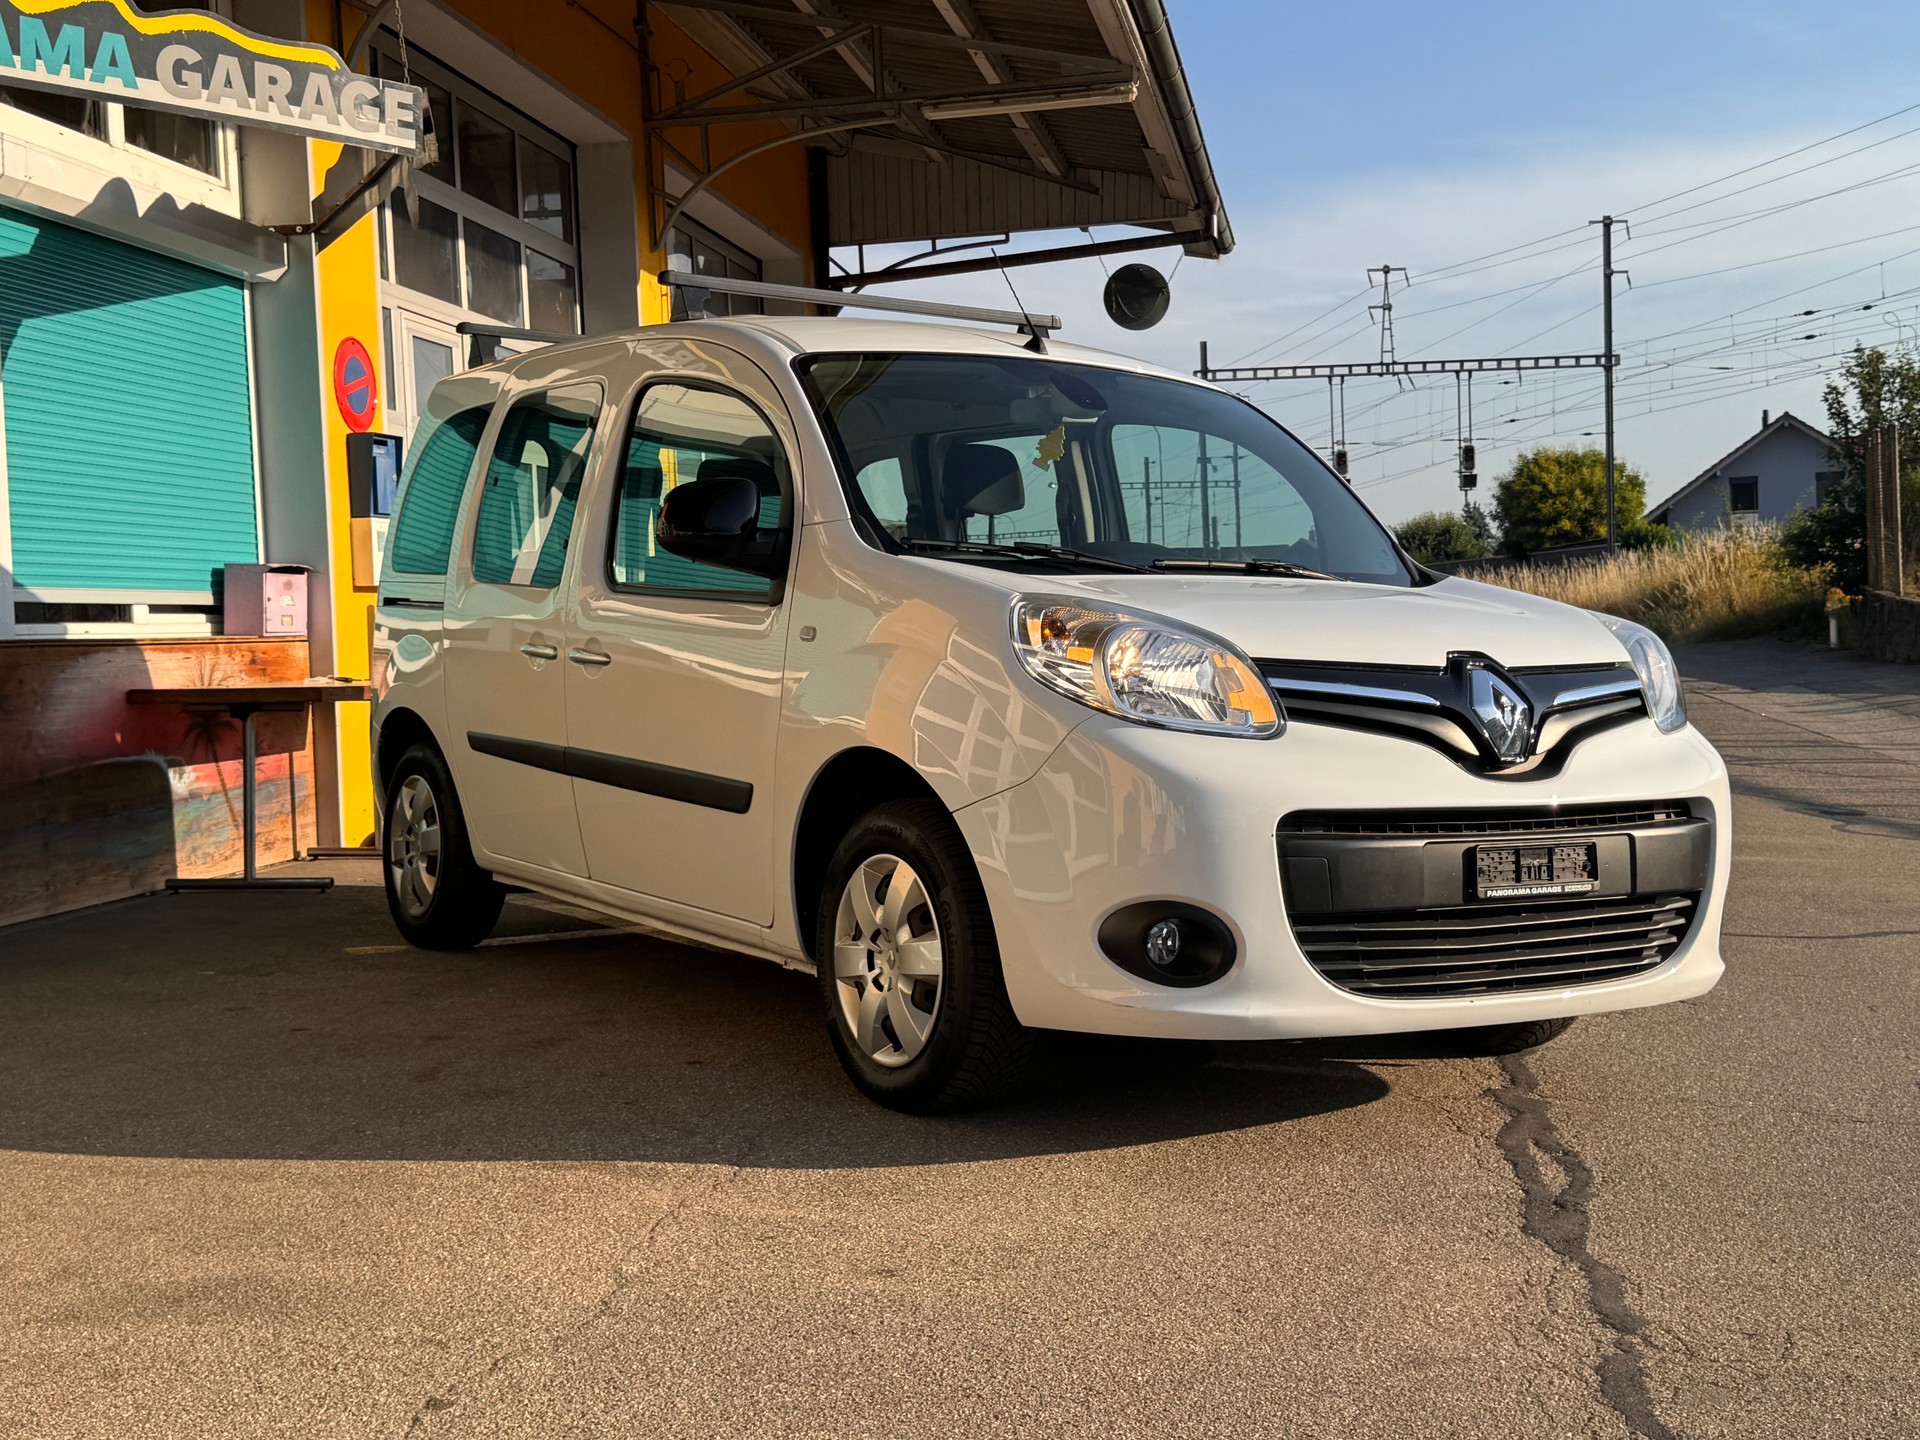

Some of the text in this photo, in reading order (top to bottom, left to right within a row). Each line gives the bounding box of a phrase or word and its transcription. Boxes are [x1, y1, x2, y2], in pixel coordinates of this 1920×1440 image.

[155, 44, 417, 138] GARAGE
[1487, 887, 1531, 897] PANORAMA
[1531, 885, 1562, 895] GARAGE
